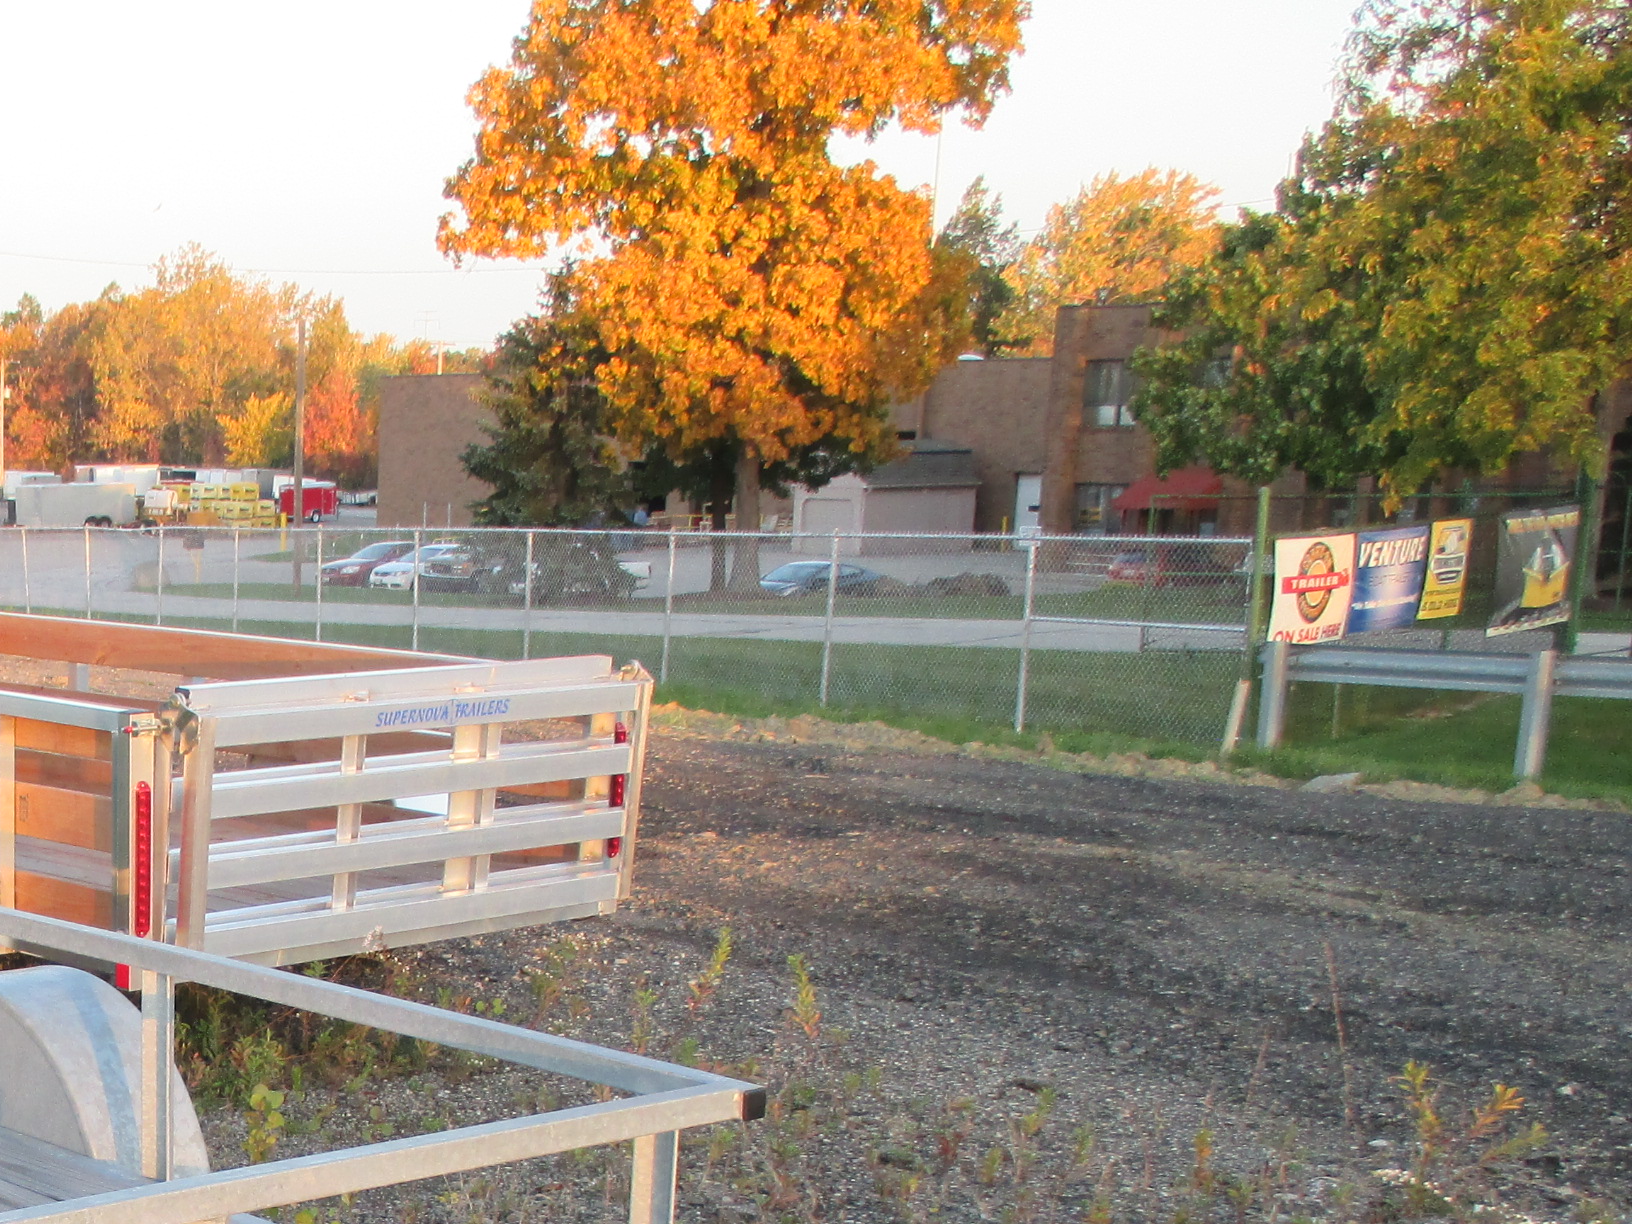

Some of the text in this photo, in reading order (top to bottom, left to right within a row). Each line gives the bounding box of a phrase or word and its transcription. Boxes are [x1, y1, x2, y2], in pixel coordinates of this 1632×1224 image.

[1358, 536, 1428, 569] VENTURE
[1290, 575, 1340, 590] TRAILER
[1273, 623, 1342, 642] ON SALE HERE
[375, 698, 511, 728] SUPERNOVA TRAILERS
